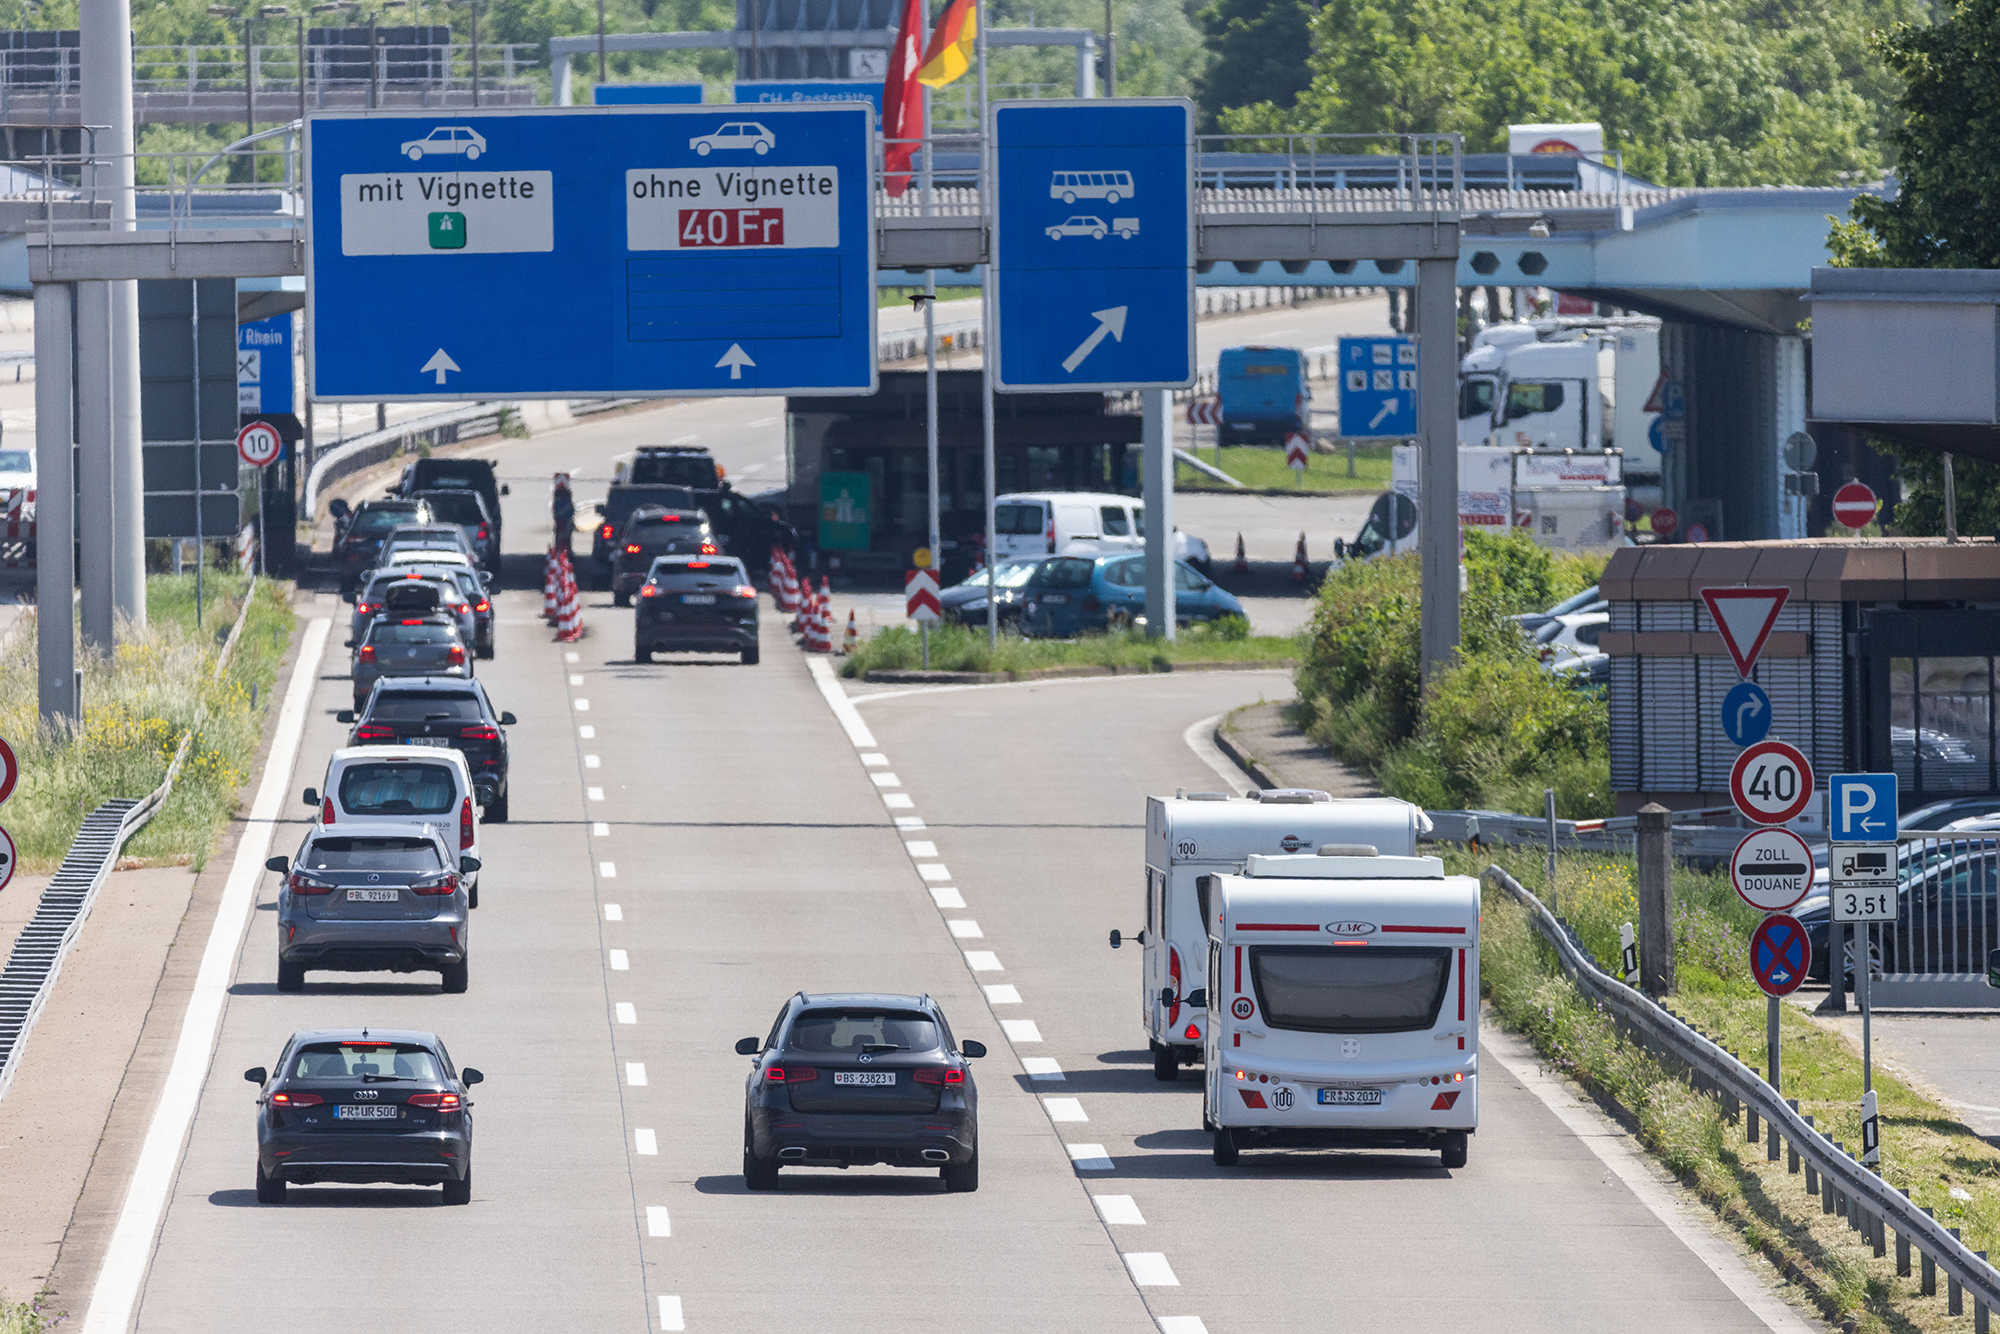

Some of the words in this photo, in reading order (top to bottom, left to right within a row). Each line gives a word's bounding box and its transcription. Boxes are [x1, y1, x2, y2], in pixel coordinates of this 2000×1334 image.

[359, 177, 404, 202] mit
[418, 176, 535, 207] Vignette
[632, 174, 701, 199] ohne
[715, 172, 833, 203] Vignette
[682, 210, 728, 244] 40
[738, 209, 780, 243] Fr
[246, 328, 283, 345] Rhein
[248, 434, 269, 454] 10
[1748, 765, 1795, 802] 40
[1841, 783, 1877, 833] P
[1177, 842, 1196, 855] 100
[1280, 840, 1311, 848] bürstner
[1755, 849, 1790, 861] ZOLL
[1744, 878, 1802, 891] DOUANE
[1336, 923, 1366, 932] LMC
[1237, 1003, 1249, 1013] 80
[1273, 1091, 1293, 1107] 100
